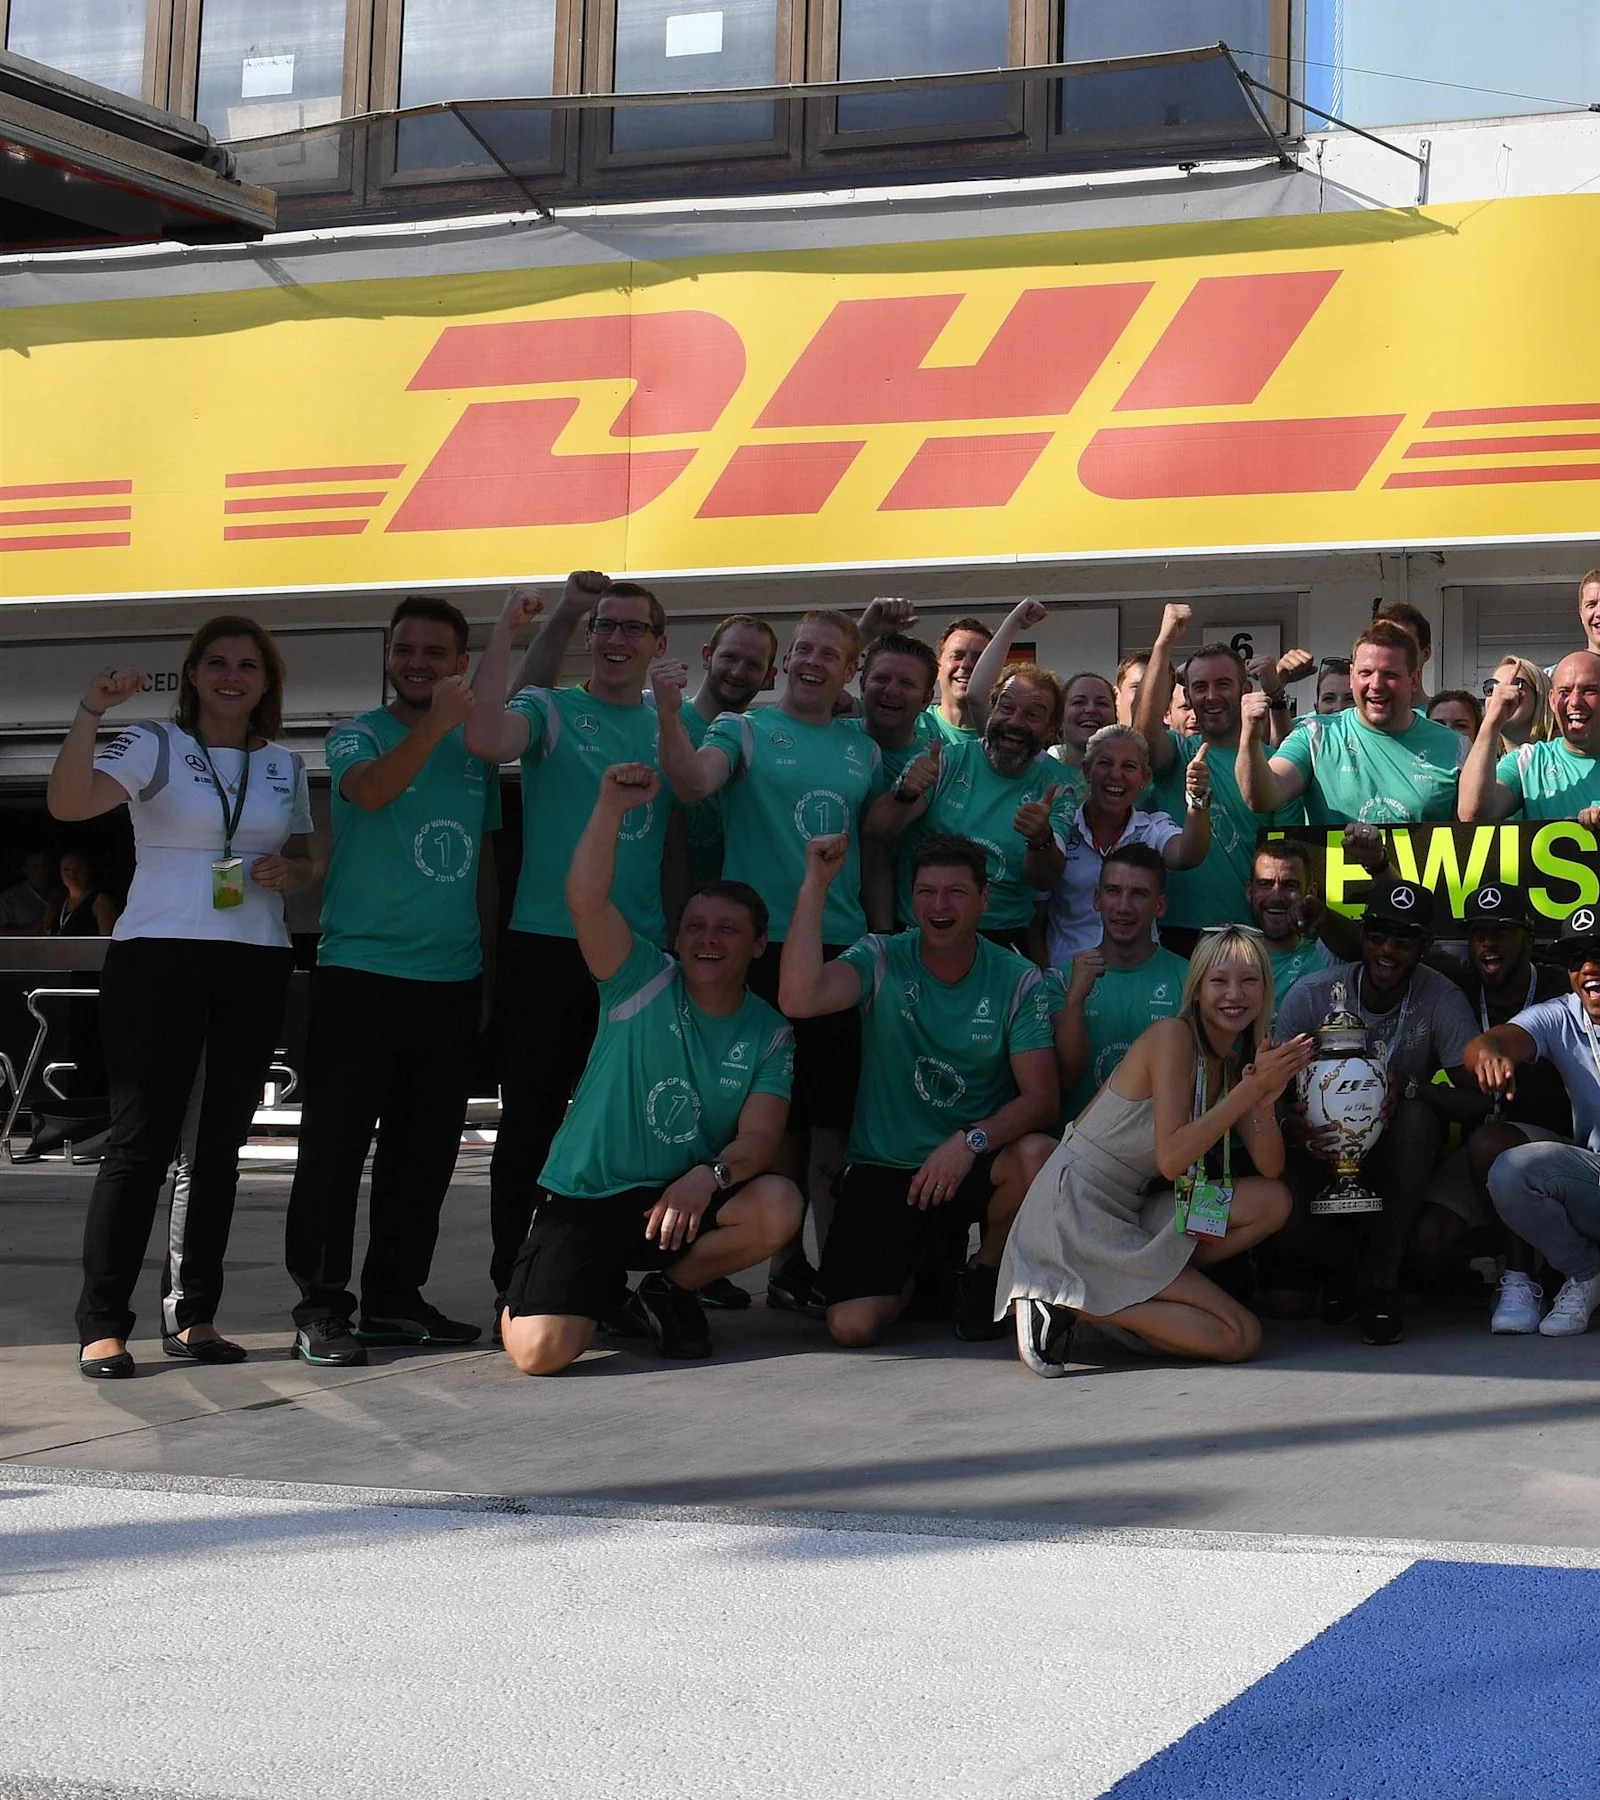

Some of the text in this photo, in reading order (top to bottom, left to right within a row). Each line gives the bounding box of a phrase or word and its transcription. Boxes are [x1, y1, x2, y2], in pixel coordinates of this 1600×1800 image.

[385, 270, 1404, 532] DHL
[1230, 633, 1254, 661] 6
[811, 790, 846, 808] WINNERS
[815, 801, 829, 829] 1
[421, 819, 465, 836] GP WINNERS
[435, 832, 450, 868] 1
[435, 873, 455, 883] 2016
[1269, 822, 1600, 919] EWIS
[667, 1077, 679, 1086] GP
[720, 1077, 743, 1087] BOSS
[1354, 1102, 1373, 1111] Place
[653, 1127, 672, 1145] 2016
